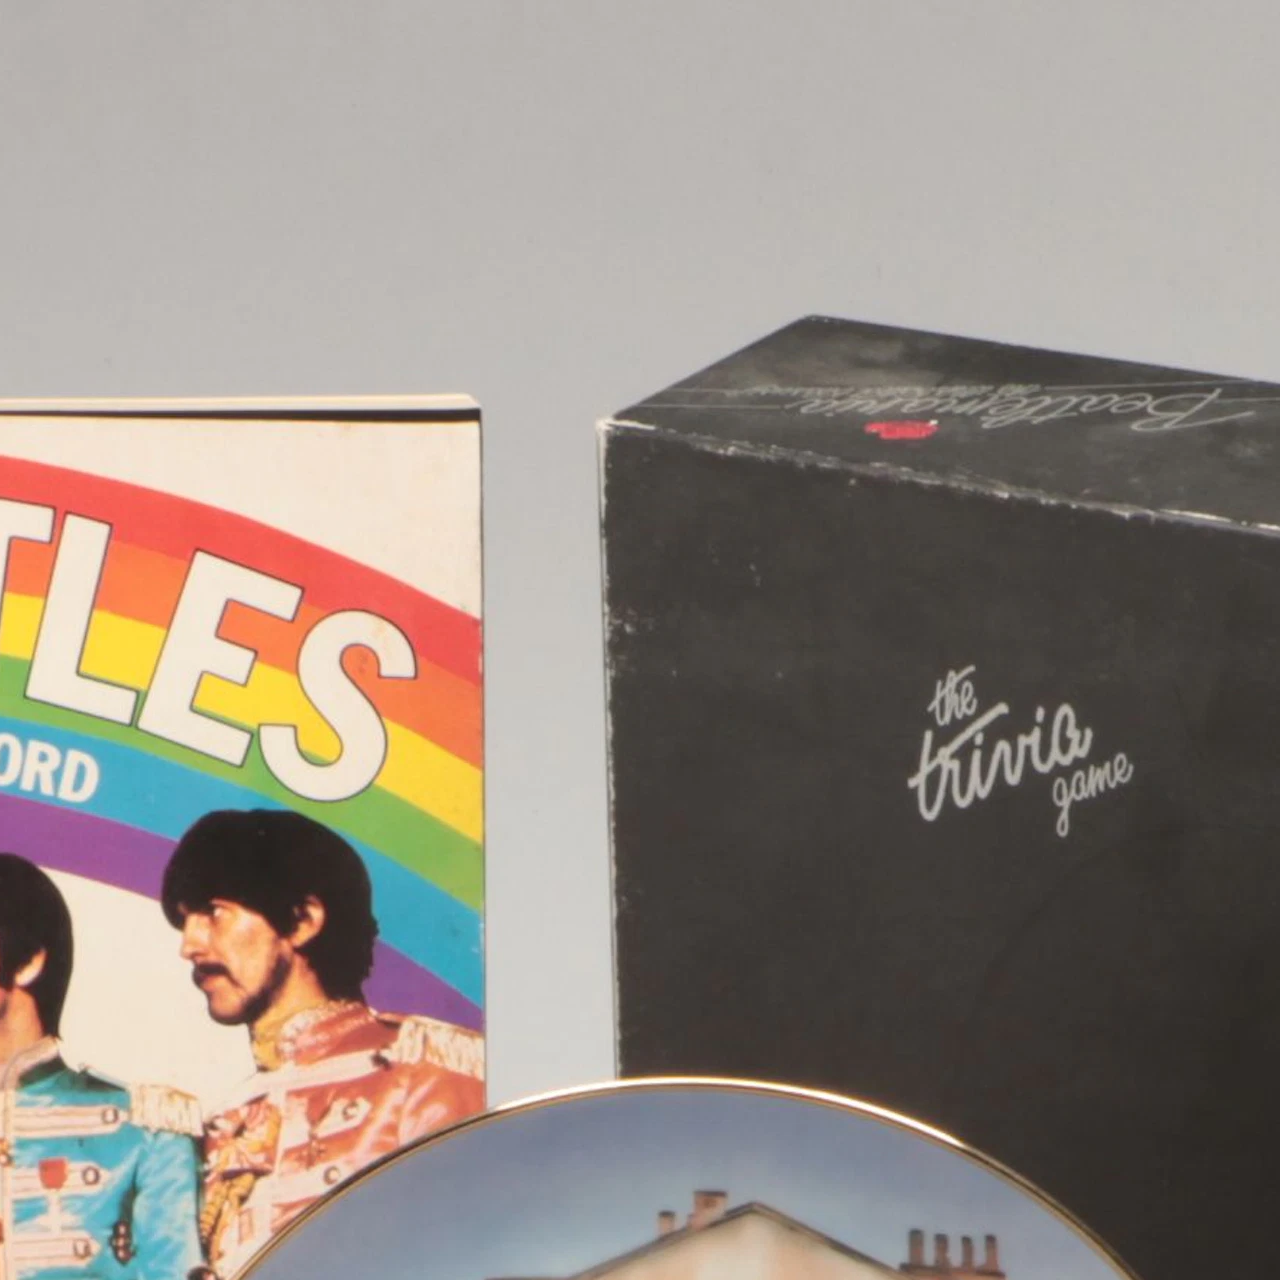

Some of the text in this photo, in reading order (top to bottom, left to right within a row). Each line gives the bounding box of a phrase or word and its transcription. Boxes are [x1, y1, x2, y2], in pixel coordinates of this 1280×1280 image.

[927, 664, 978, 726] the
[907, 701, 1094, 822] trivia
[1052, 752, 1134, 838] game
